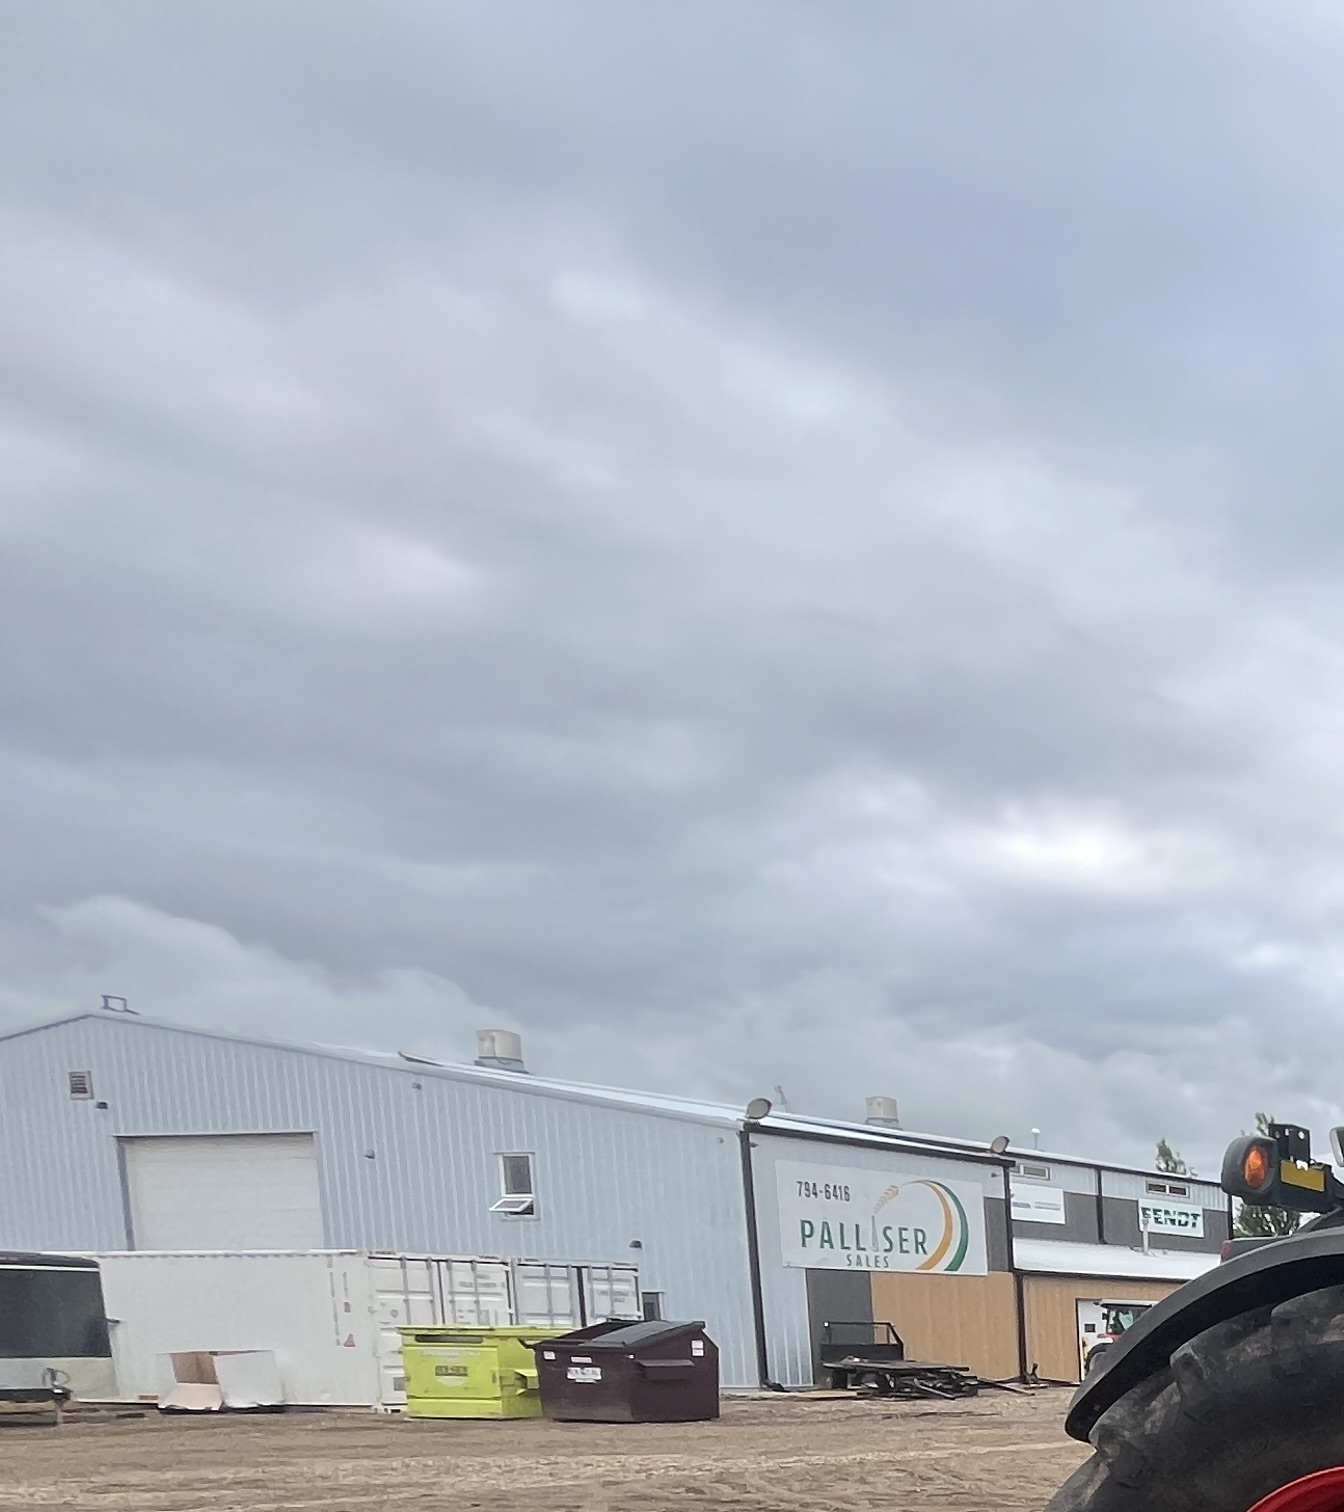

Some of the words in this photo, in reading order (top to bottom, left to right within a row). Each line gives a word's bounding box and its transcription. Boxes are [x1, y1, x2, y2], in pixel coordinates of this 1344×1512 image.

[796, 1181, 850, 1202] 794-6416
[800, 1215, 928, 1255] PALLISER
[846, 1254, 889, 1268] SALES
